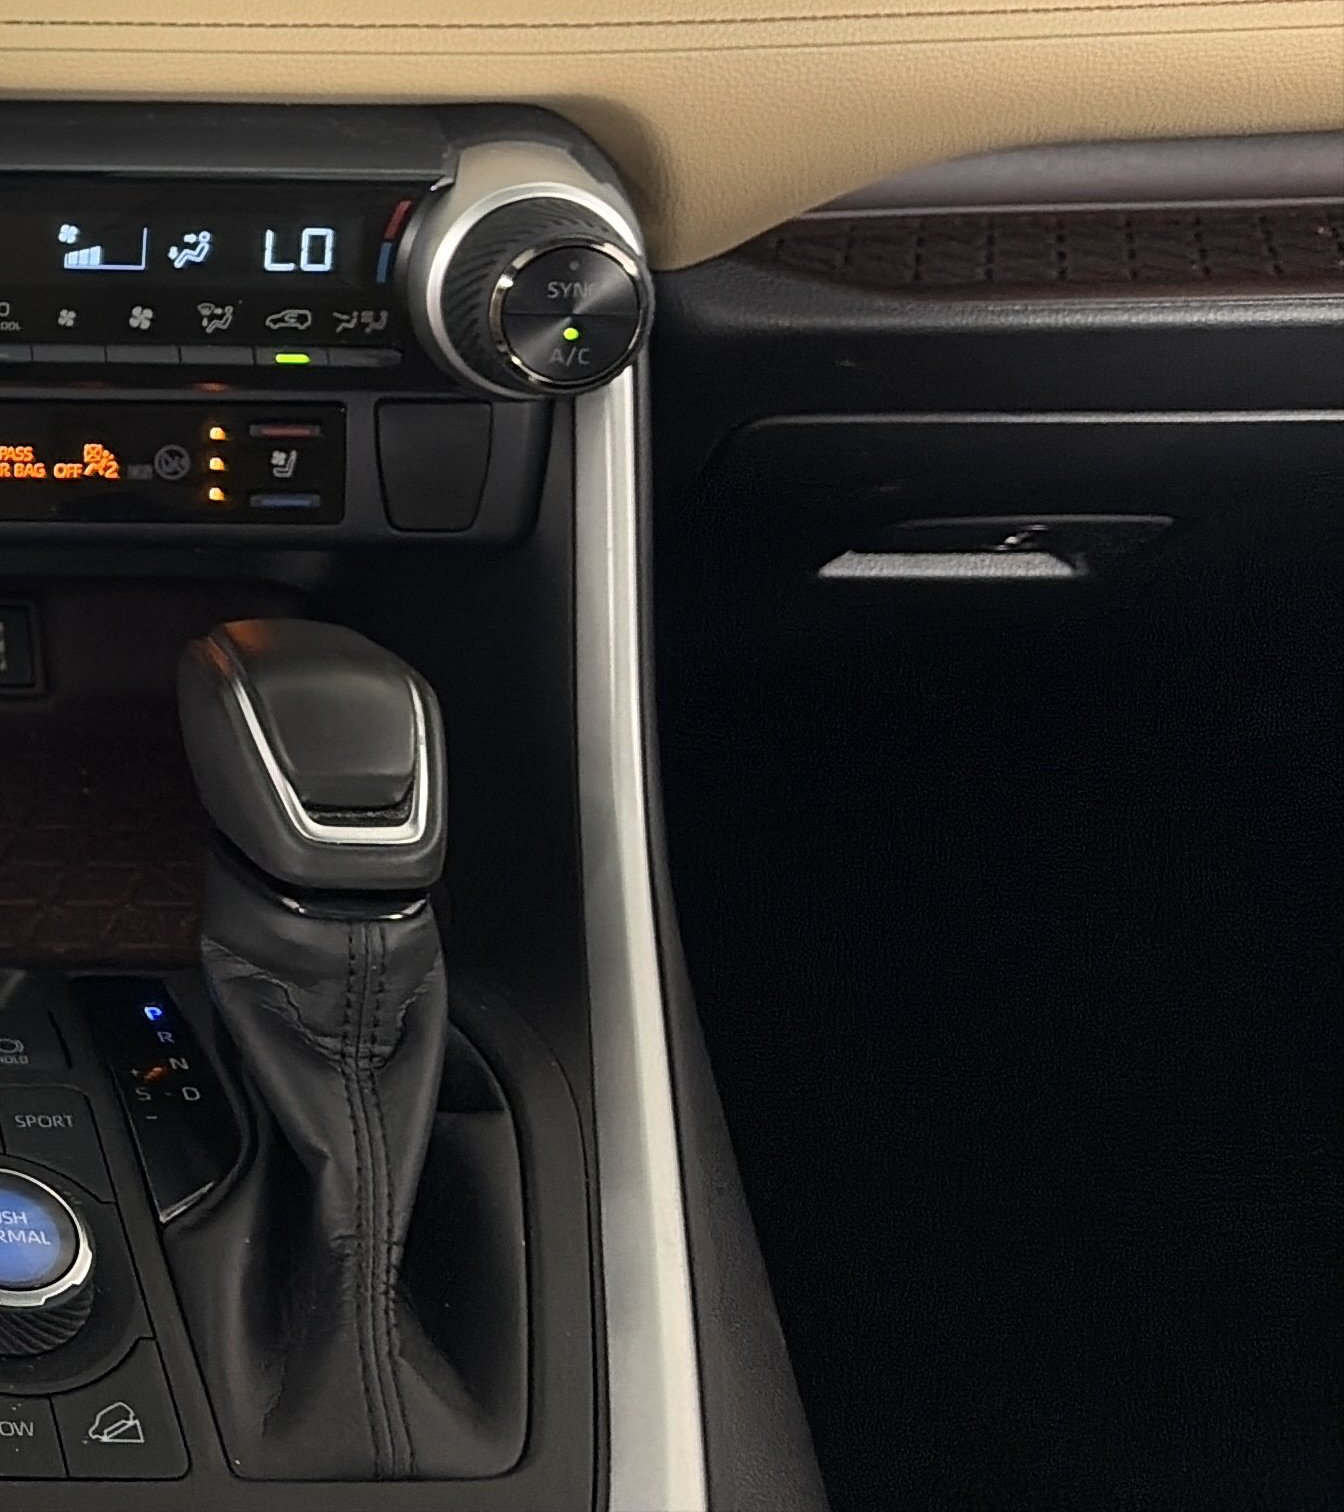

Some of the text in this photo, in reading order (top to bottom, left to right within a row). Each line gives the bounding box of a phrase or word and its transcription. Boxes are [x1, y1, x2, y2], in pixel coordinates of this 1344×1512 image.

[263, 226, 335, 272] LO
[550, 346, 591, 366] A/C
[13, 462, 47, 479] BAG
[53, 462, 84, 480] OFF
[143, 1006, 163, 1021] P
[157, 1030, 174, 1044] R
[169, 1056, 189, 1070] N
[135, 1087, 152, 1101] S
[181, 1086, 201, 1101] D
[14, 1113, 74, 1129] SPORT
